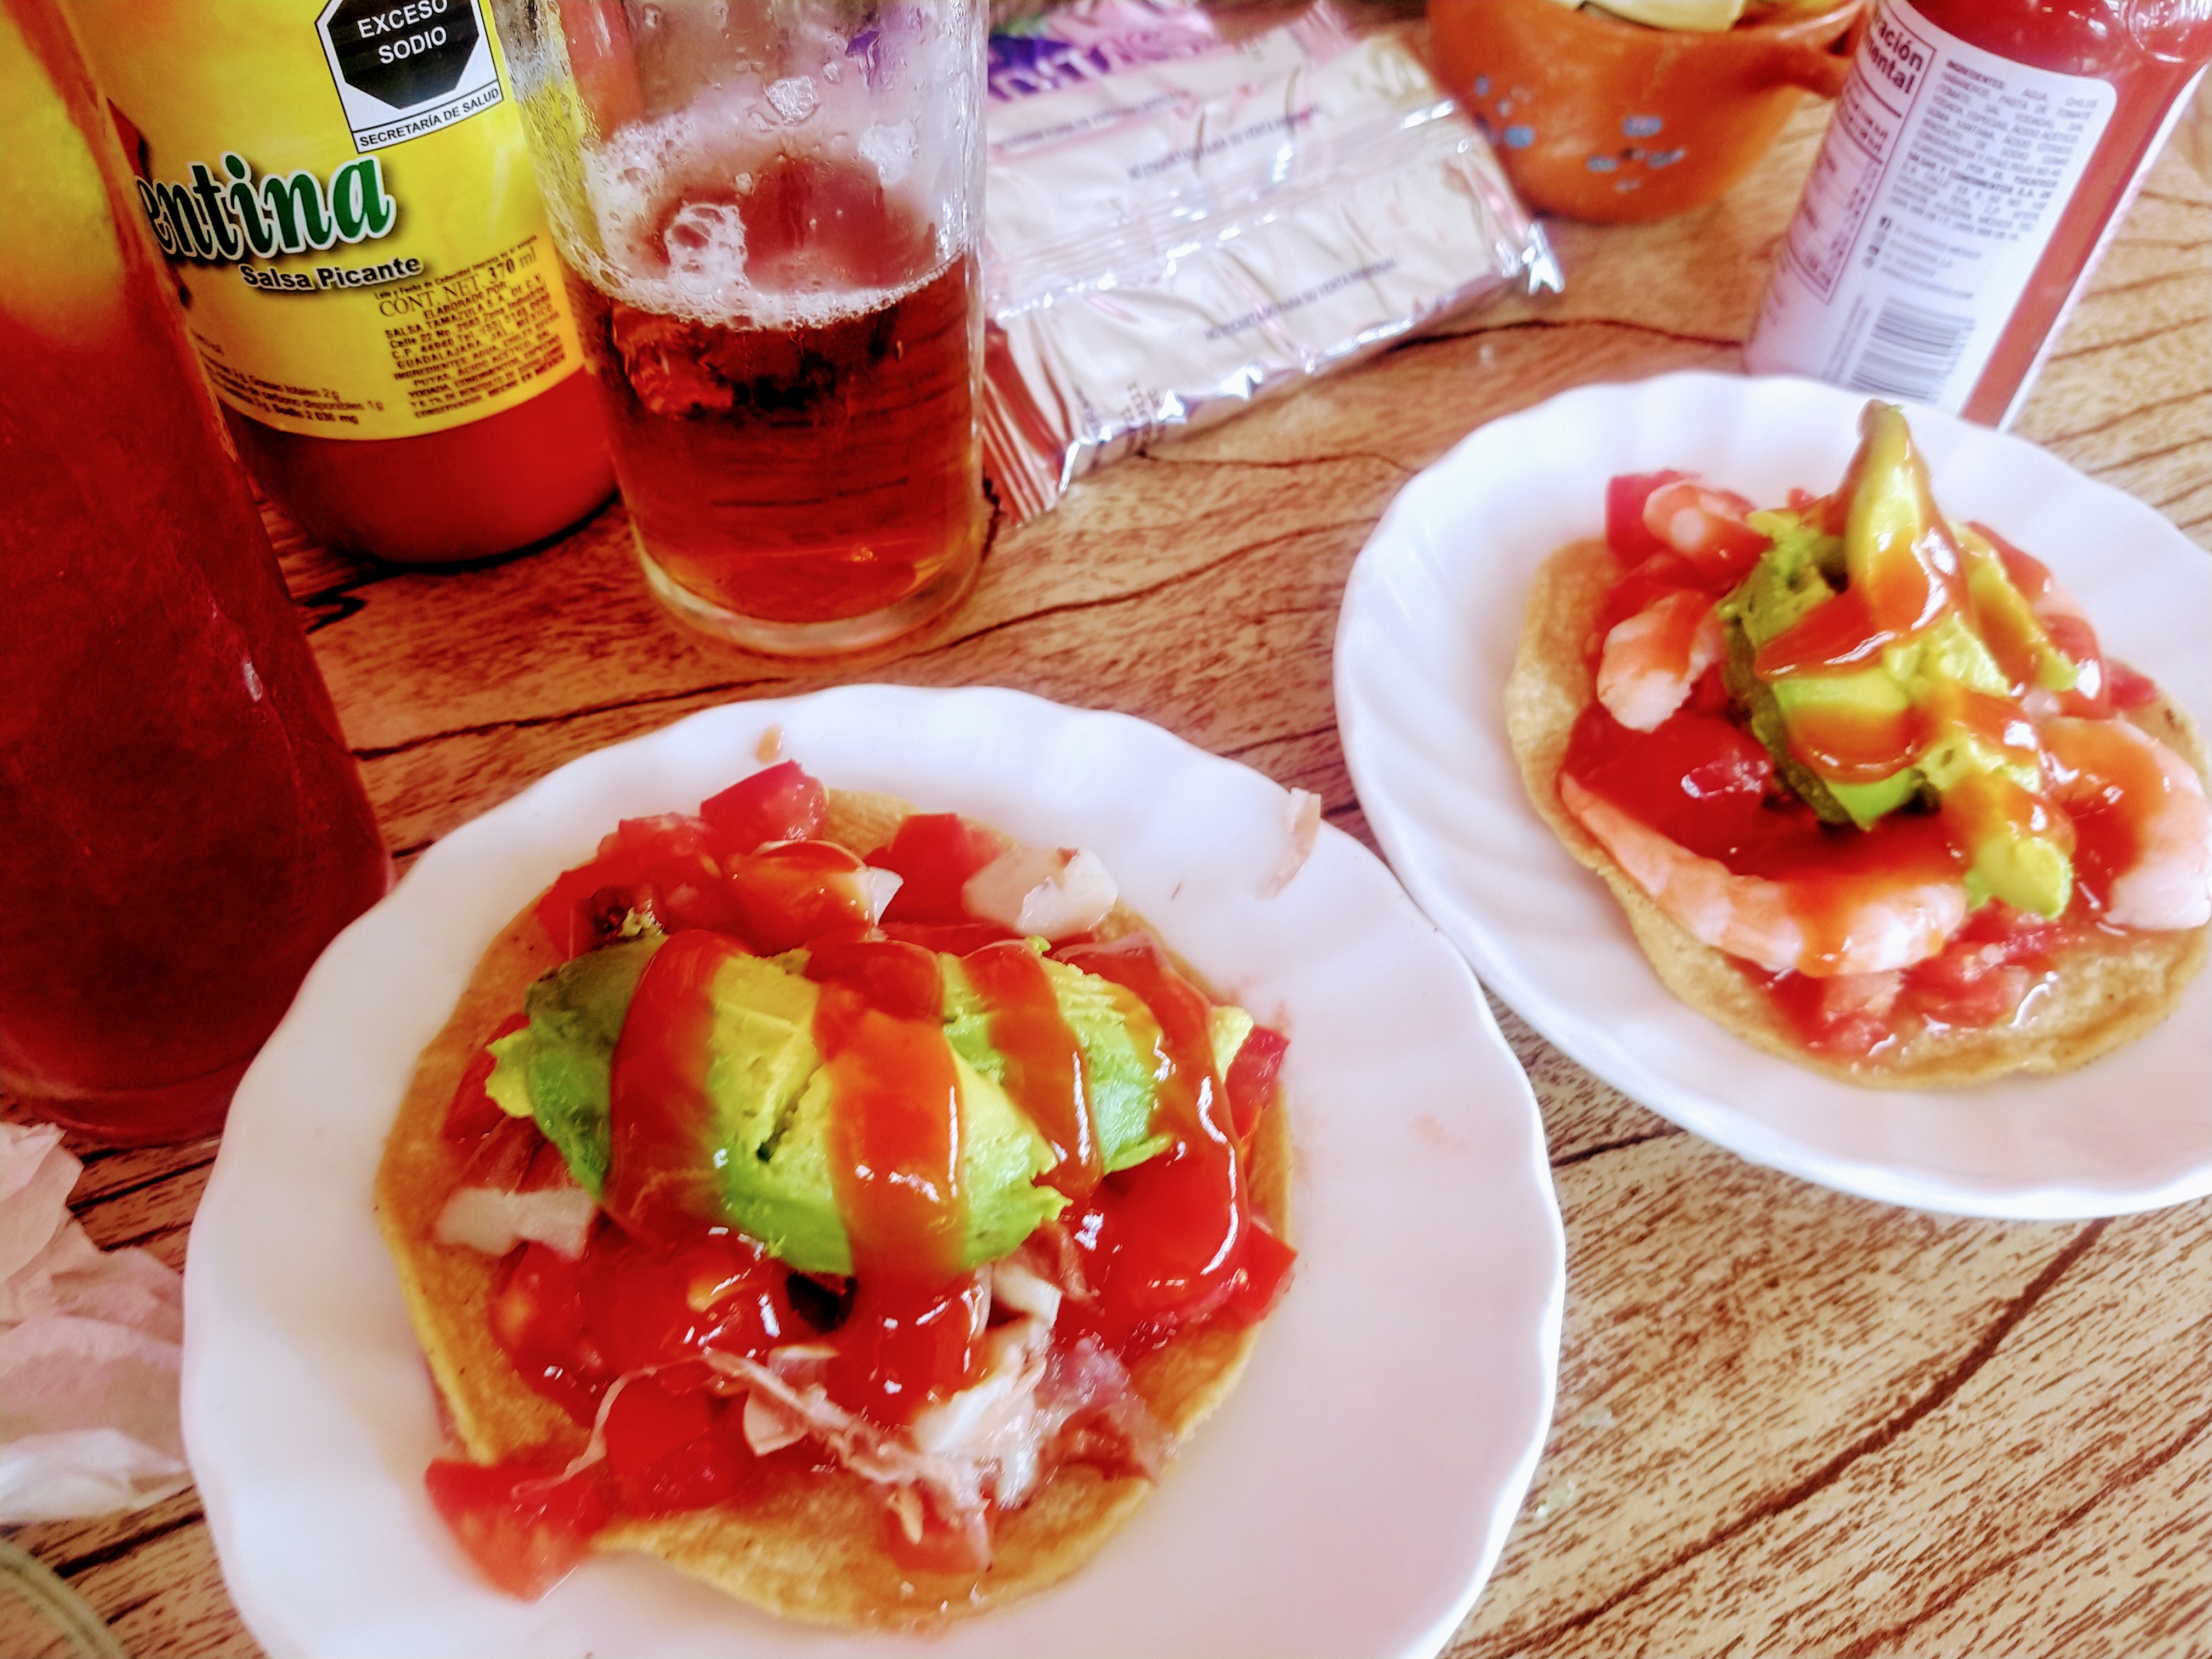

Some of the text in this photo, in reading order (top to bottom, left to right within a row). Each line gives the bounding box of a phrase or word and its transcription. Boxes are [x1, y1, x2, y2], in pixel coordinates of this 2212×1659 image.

[357, 0, 448, 38] EXCESO
[379, 26, 447, 64] SODIO
[1872, 15, 1923, 71] ación
[360, 88, 499, 146] SECRETARÍA DE SALUD
[239, 257, 423, 290] Salsa Picante
[488, 258, 516, 284] 370
[520, 246, 537, 269] ml
